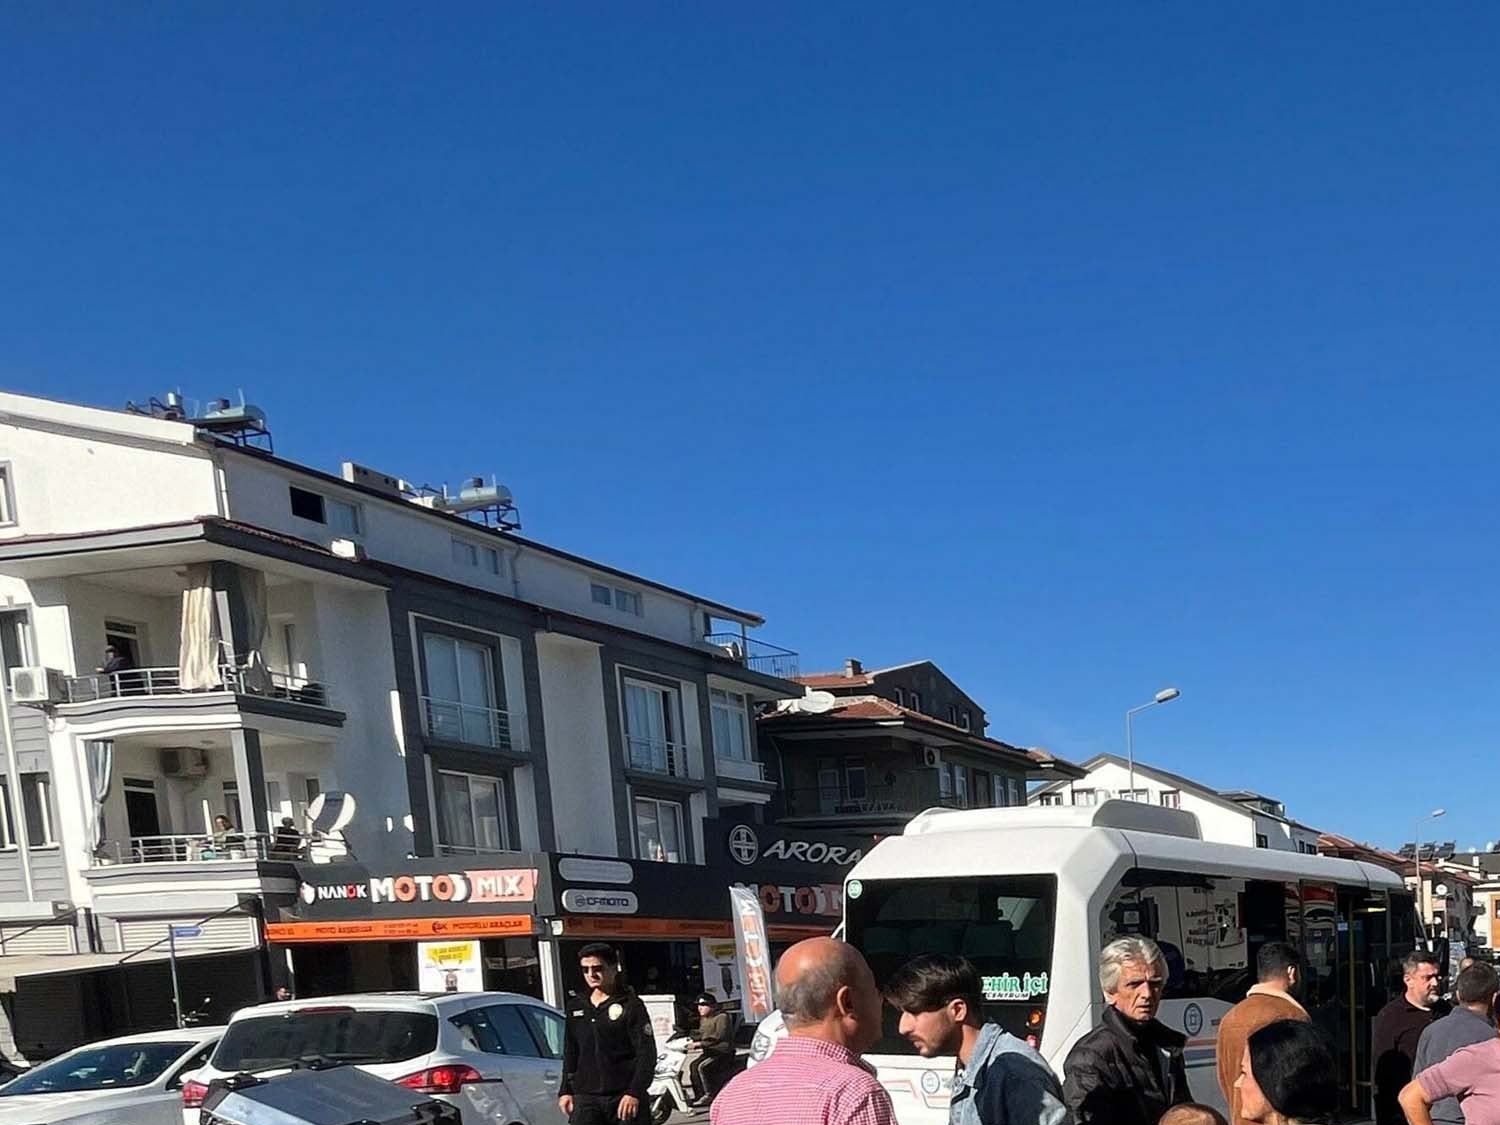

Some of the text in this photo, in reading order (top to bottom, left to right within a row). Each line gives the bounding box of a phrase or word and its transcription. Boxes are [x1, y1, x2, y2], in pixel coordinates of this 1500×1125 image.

[762, 840, 862, 866] ARORA
[370, 874, 525, 902] MOTO MIX
[981, 971, 1049, 996] EHİR İÇİ
